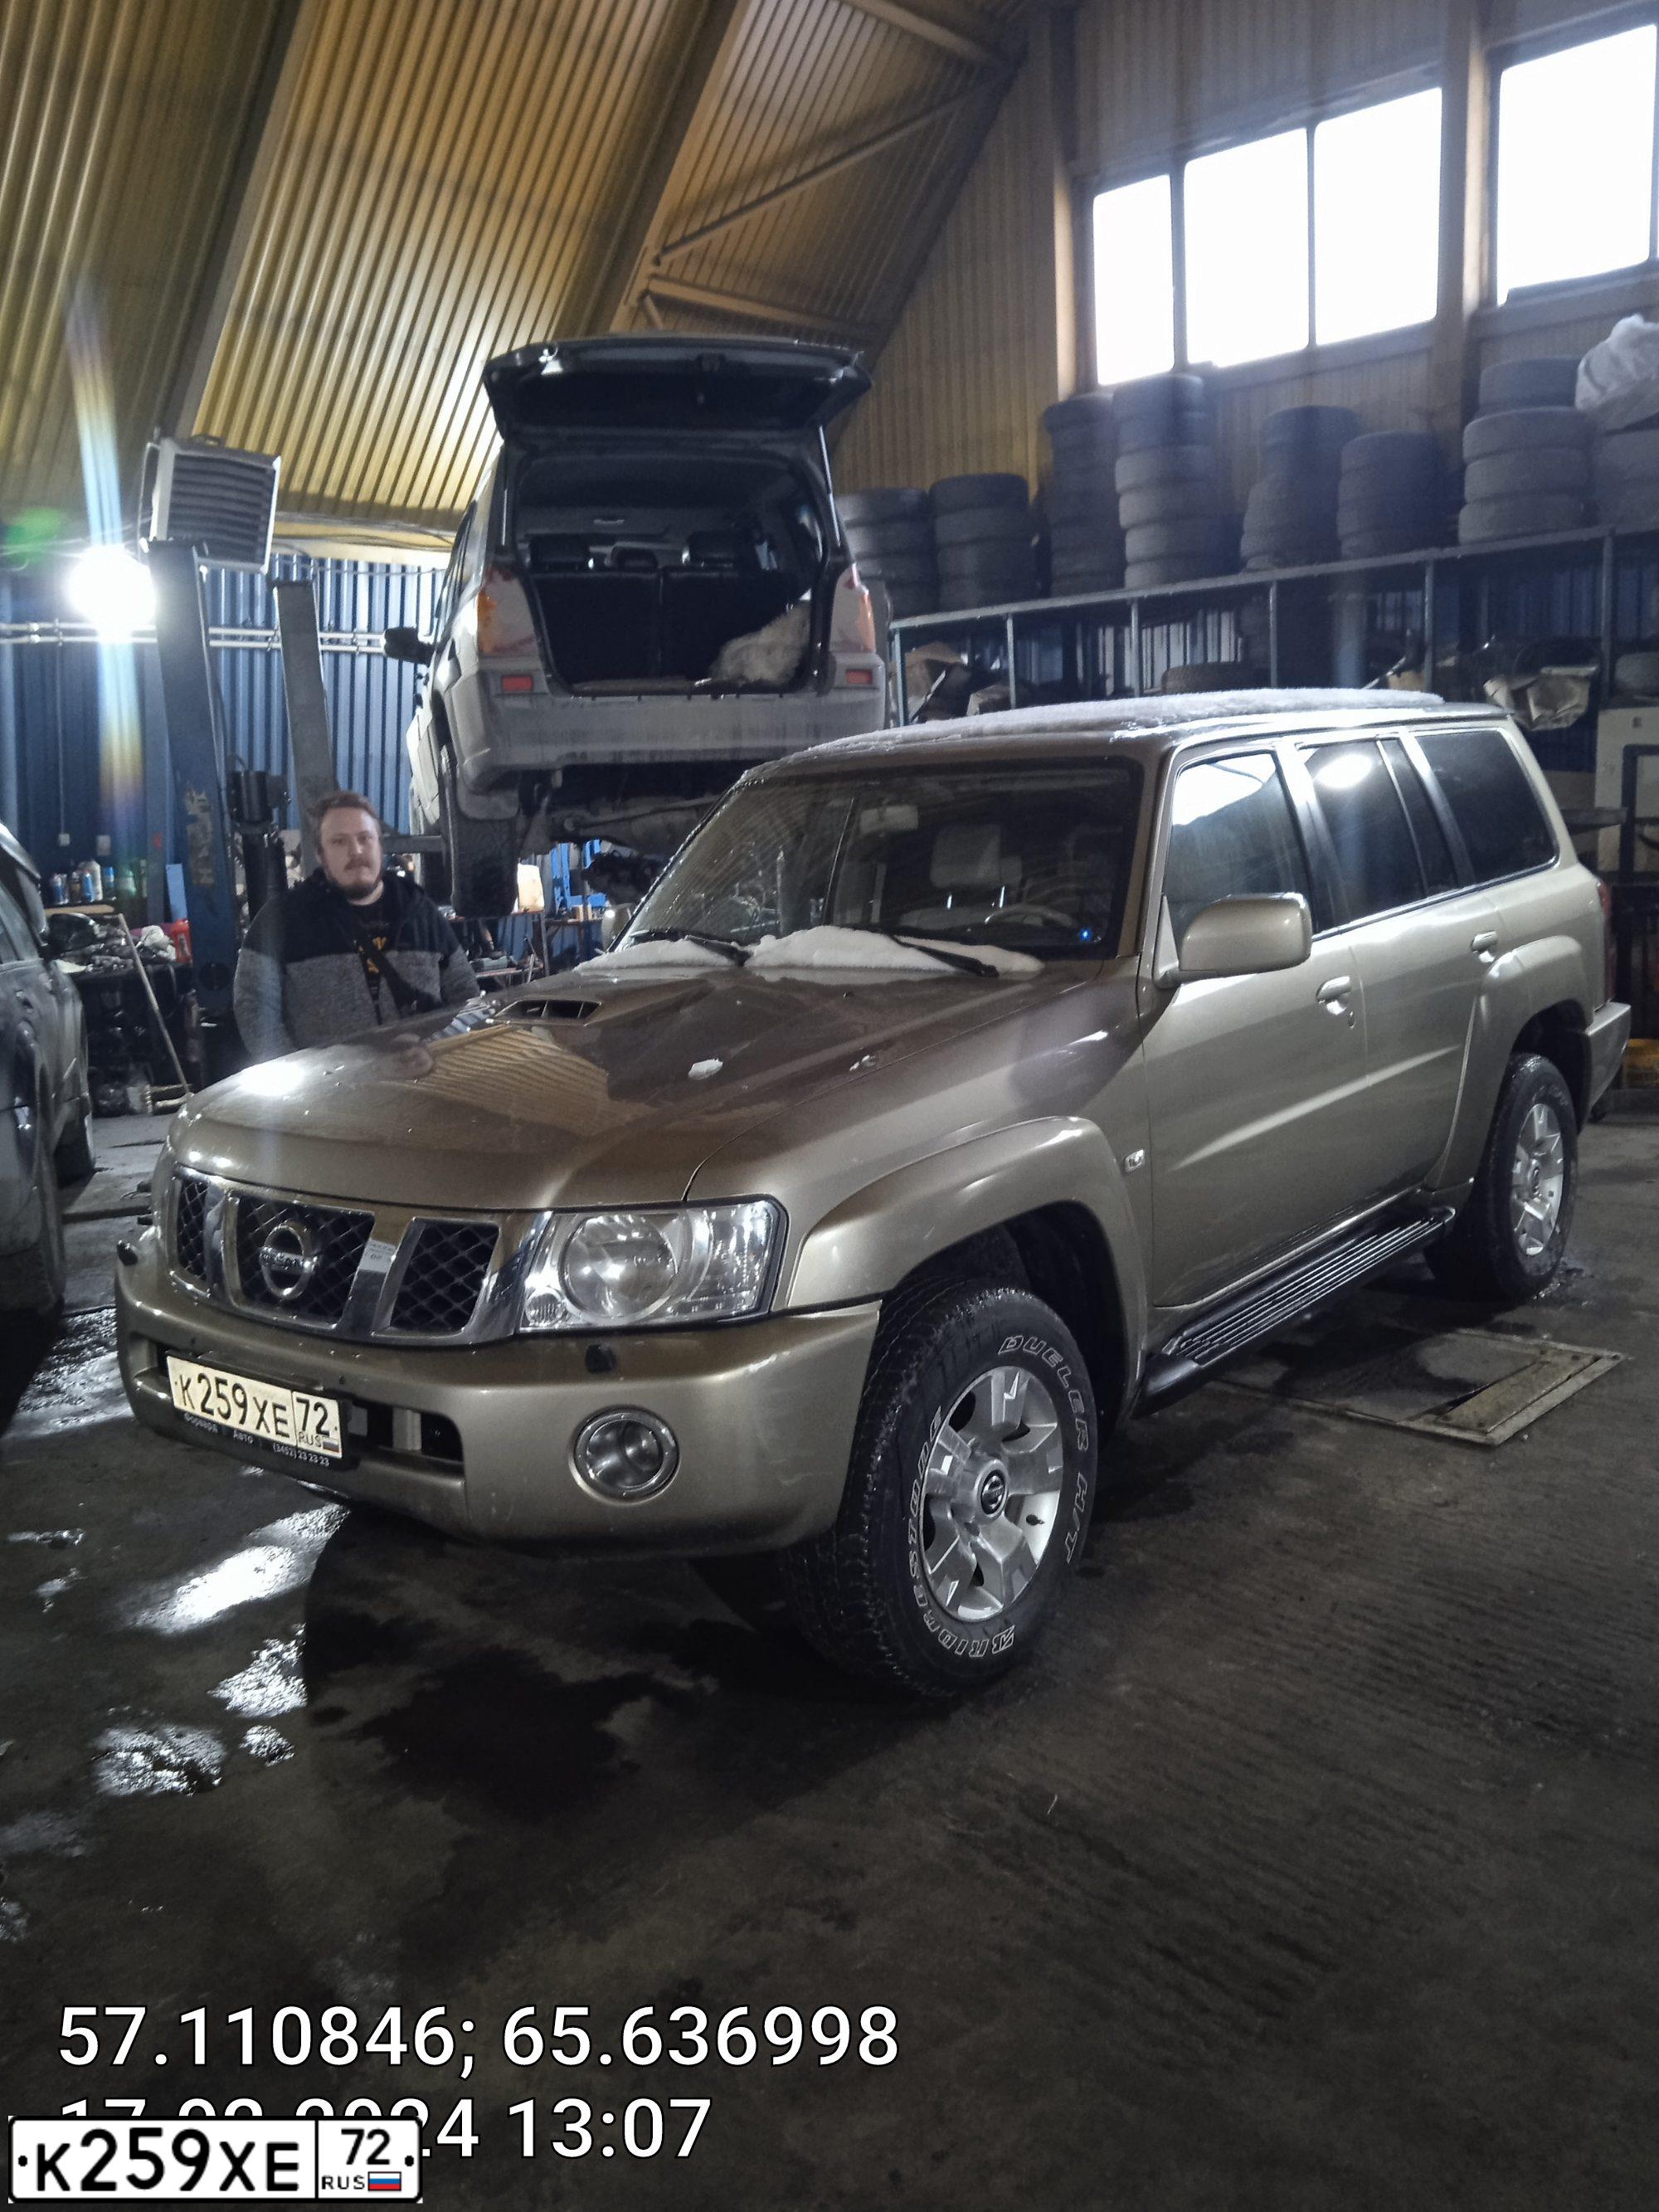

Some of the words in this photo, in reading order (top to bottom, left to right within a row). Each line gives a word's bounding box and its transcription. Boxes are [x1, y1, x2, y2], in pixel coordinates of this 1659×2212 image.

[295, 1397, 331, 1436] 72
[298, 1431, 322, 1447] RUS
[998, 1335, 1089, 1451] DUELER
[1064, 1471, 1088, 1565] H/T
